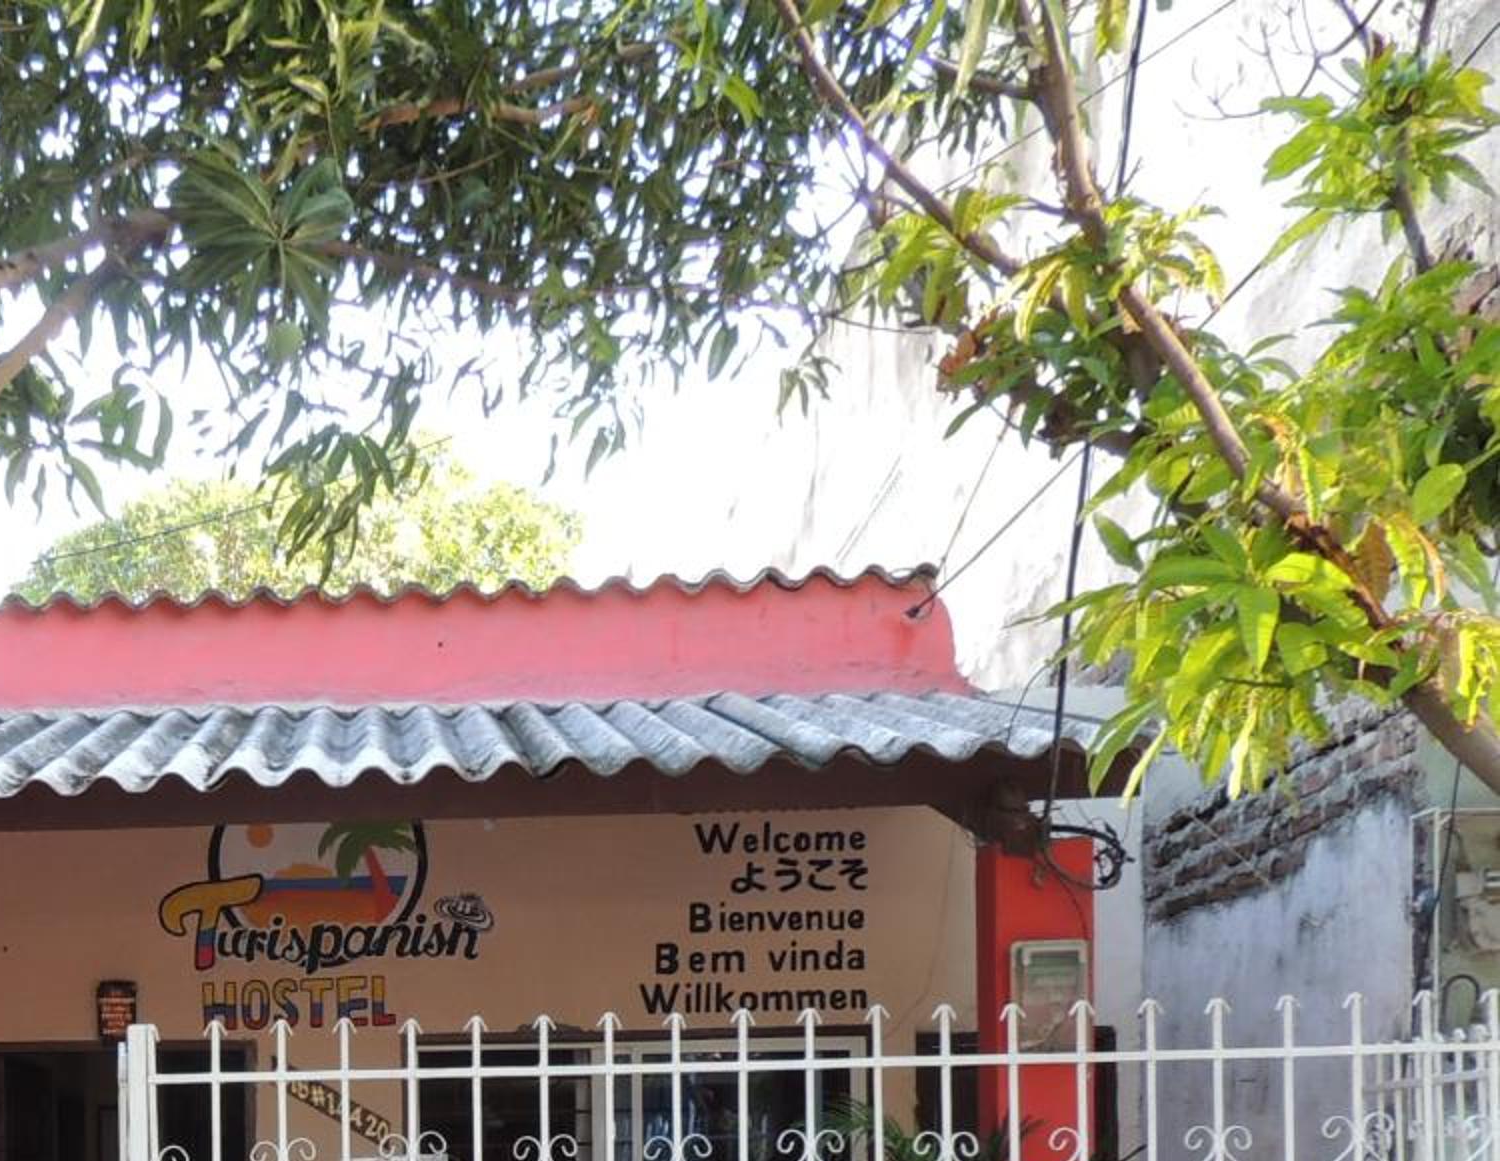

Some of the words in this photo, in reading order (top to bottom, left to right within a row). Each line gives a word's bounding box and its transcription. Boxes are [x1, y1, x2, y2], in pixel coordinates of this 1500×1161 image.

[694, 821, 867, 854] Welcome
[730, 857, 869, 893] ようこそ
[158, 872, 481, 974] Turispanish
[689, 902, 866, 933] Bienvenue
[655, 942, 746, 975] Bem
[767, 939, 866, 972] vinda
[201, 975, 397, 1032] HOSTEL
[640, 982, 868, 1014] Willkommen
